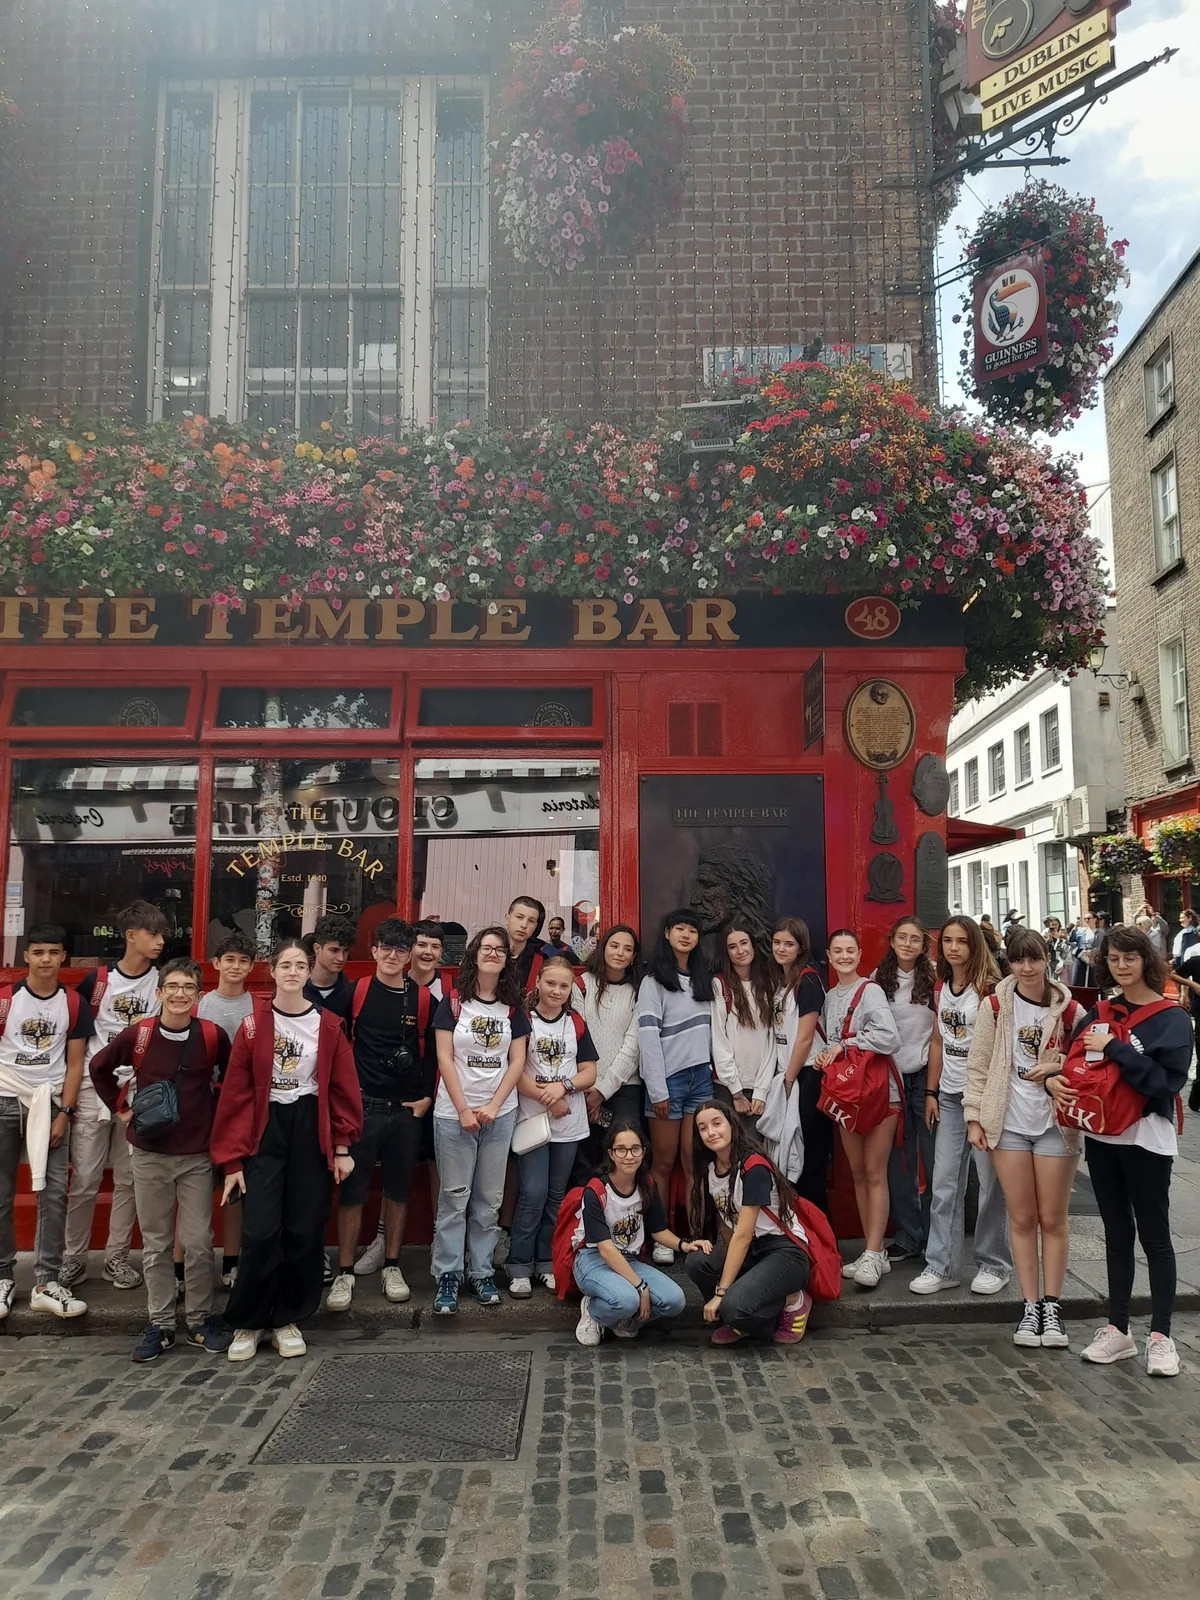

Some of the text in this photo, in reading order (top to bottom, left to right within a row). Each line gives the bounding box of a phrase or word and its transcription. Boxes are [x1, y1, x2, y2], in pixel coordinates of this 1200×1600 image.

[1003, 28, 1082, 86] DUBLIN
[991, 50, 1099, 123] LIVE MUSIC
[892, 354, 905, 373] 2
[985, 337, 1037, 364] GUINNESS
[985, 348, 1037, 371] is good for you
[0, 597, 740, 641] THE TEMPLE BAR
[853, 605, 890, 632] 48
[289, 807, 323, 820] THE
[675, 808, 788, 818] THE TEMPLE BAR
[226, 832, 328, 878] TEMPLE
[336, 838, 384, 881] BAR
[281, 874, 327, 883] Estd. 1840
[828, 1100, 852, 1130] LK
